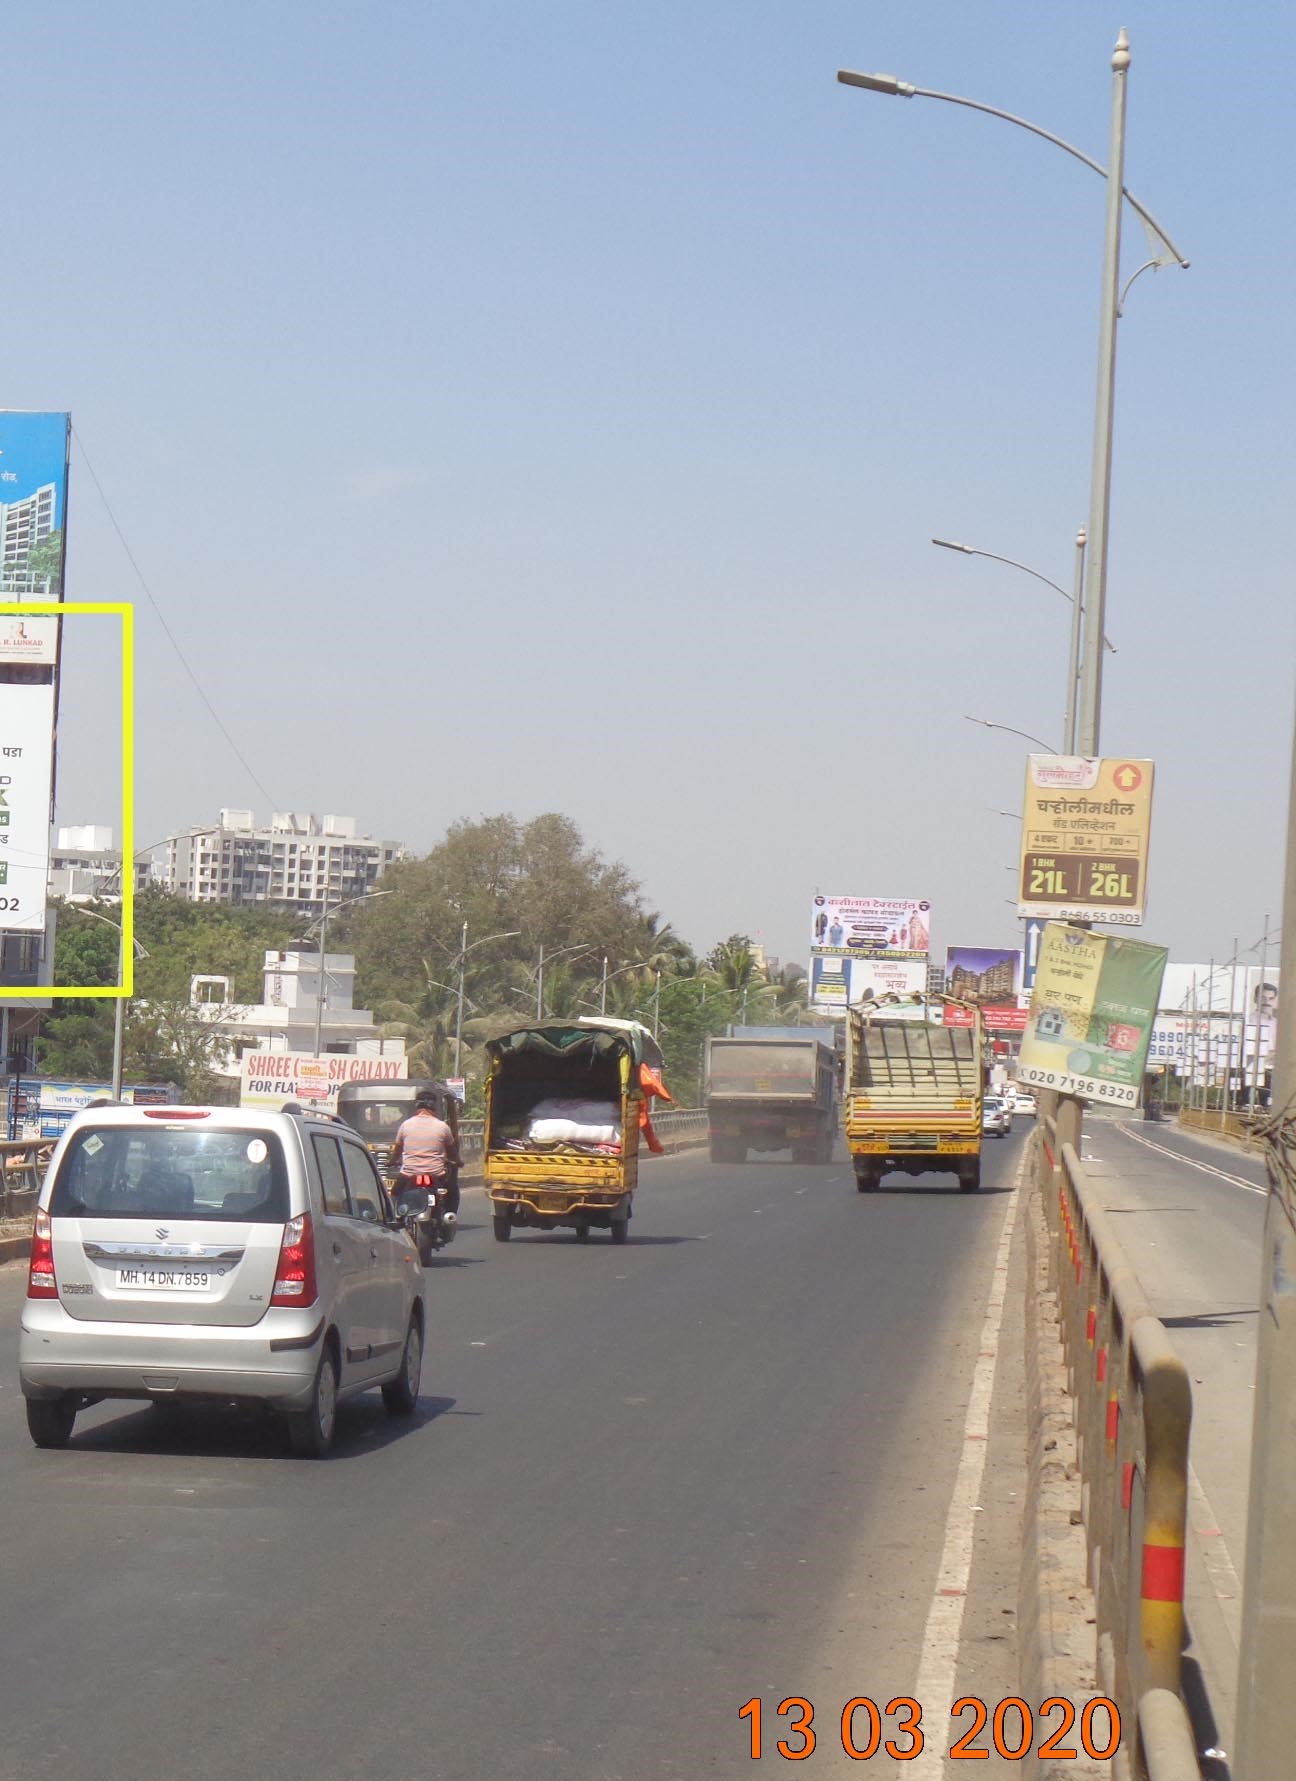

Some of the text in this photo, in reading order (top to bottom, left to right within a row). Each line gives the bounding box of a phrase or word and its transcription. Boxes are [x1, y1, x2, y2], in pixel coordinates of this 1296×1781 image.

[13, 639, 44, 647] LUNKAD
[2, 746, 23, 758] पडा
[1038, 859, 1056, 868] BHK
[1091, 862, 1116, 872] 2 BHK
[1092, 911, 1107, 922] 55
[1109, 913, 1141, 924] 0303
[1047, 940, 1097, 959] AASTHA
[248, 1055, 290, 1078] SHREE
[248, 1080, 272, 1093] FOR
[1029, 1069, 1135, 1101] 020 7196 8320
